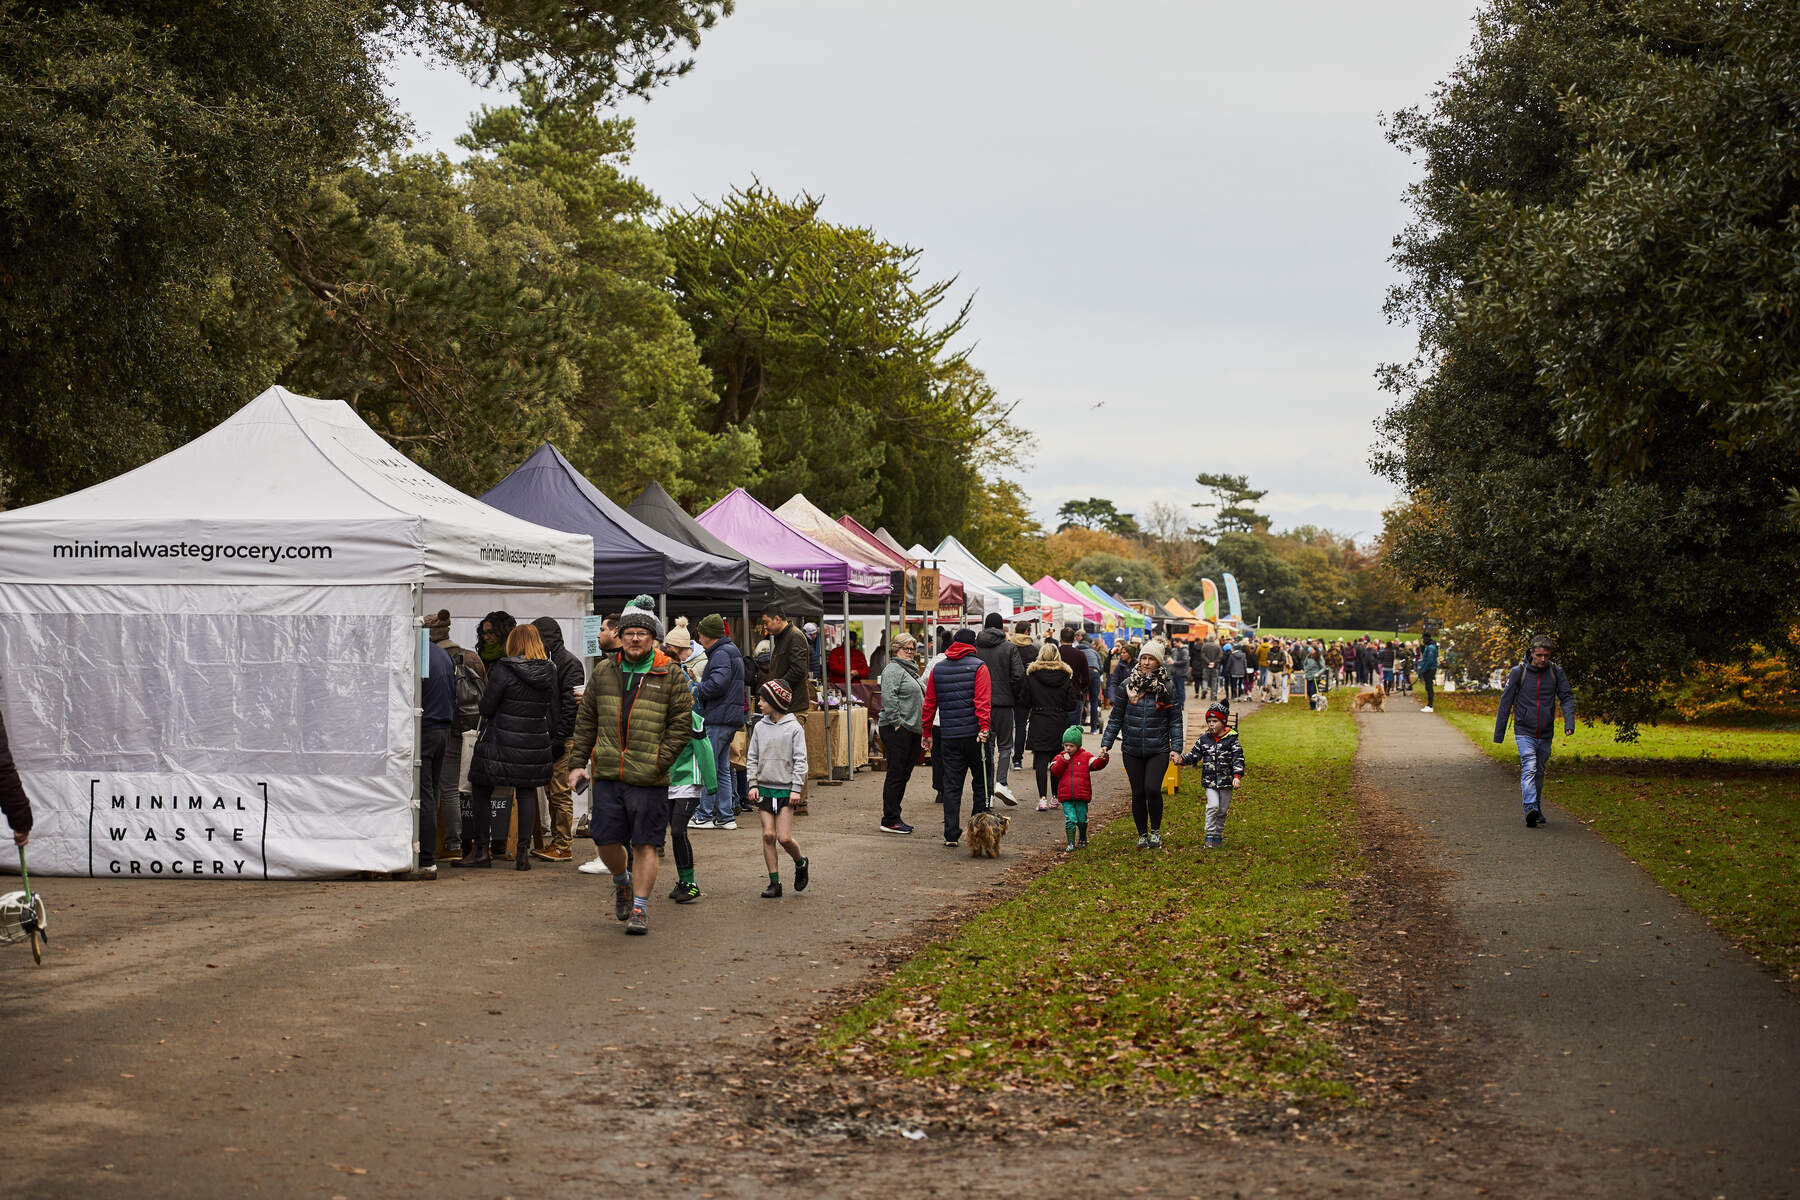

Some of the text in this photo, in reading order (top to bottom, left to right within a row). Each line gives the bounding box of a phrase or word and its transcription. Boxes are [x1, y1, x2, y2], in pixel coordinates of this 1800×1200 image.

[53, 540, 332, 563] minimalwastegrocery.com
[480, 543, 557, 569] minimalwastegrocery.com
[802, 569, 820, 584] Oil
[772, 684, 791, 701] FACE
[111, 795, 246, 811] MINIMAL
[109, 827, 244, 842] WASTE
[109, 859, 246, 875] GROCERY
